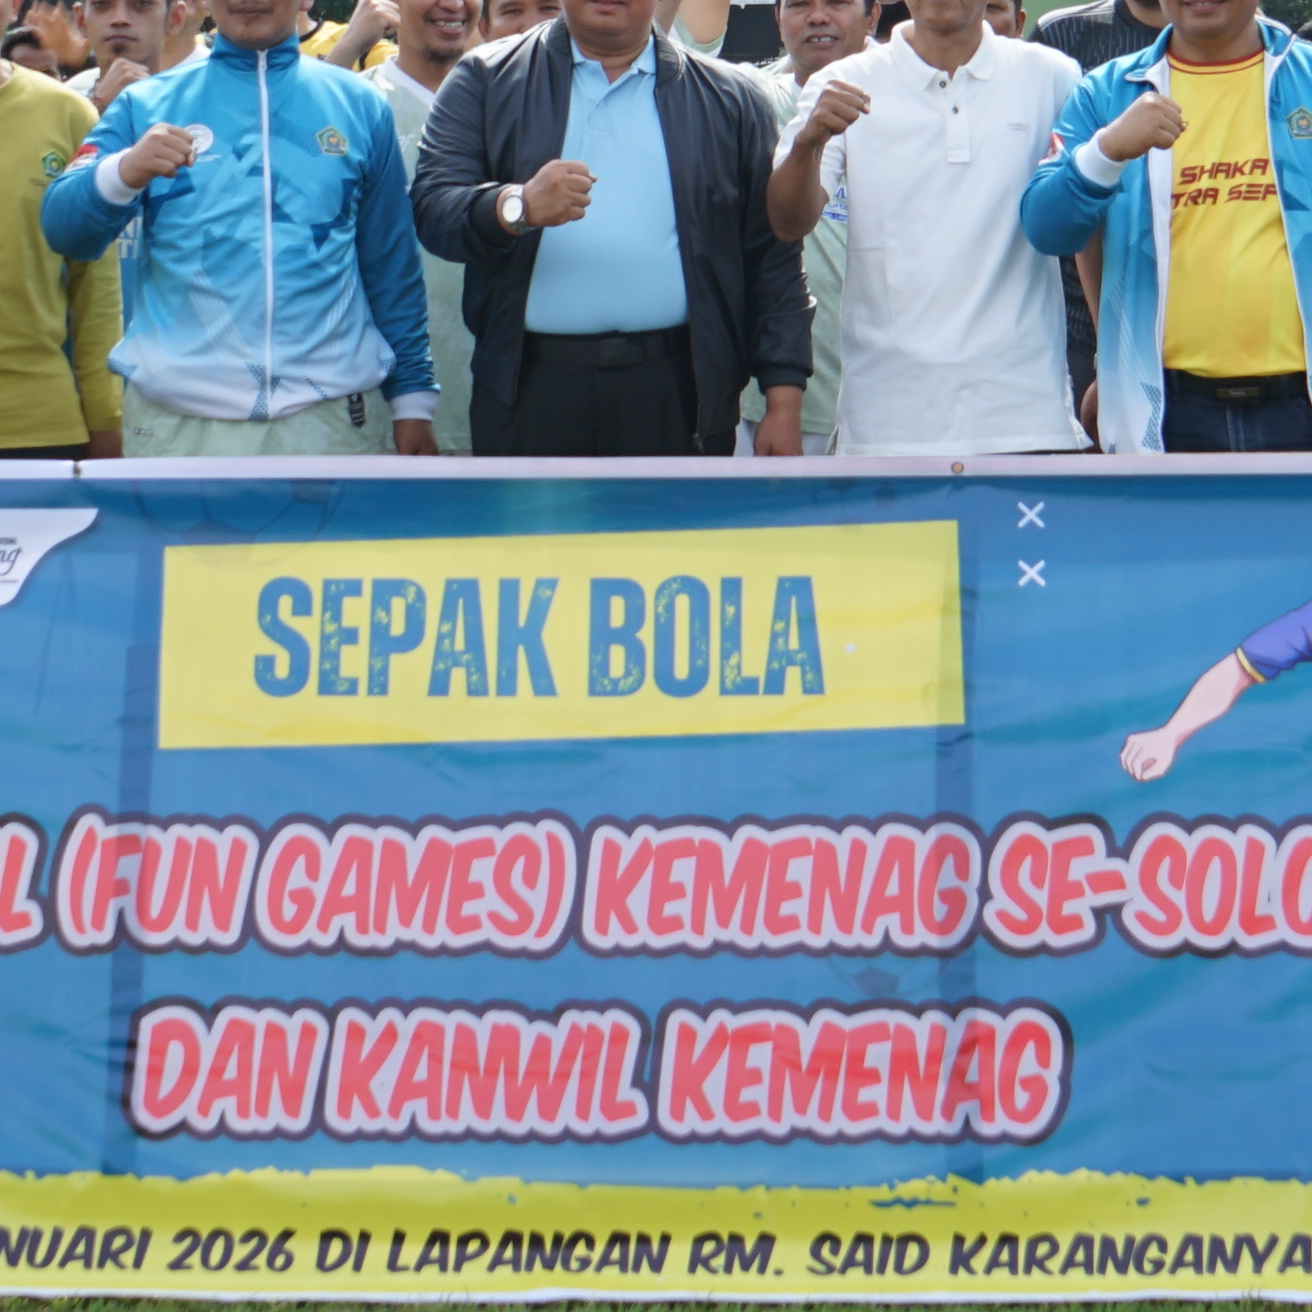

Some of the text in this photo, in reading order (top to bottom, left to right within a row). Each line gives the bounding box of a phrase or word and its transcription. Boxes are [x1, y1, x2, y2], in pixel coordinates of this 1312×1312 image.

[1176, 157, 1270, 186] SHAKA
[253, 574, 826, 698] SEPAK BOLA
[68, 825, 249, 935] (FUN
[266, 830, 567, 939] GAMES)
[593, 833, 971, 938] KEMENAG
[141, 1017, 1053, 1125] DAN KANWIL KEMENAG
[166, 1227, 297, 1272] 2026
[315, 1228, 373, 1273] DI
[386, 1228, 672, 1274] LAPANGAN
[687, 1230, 785, 1276] RM.
[805, 1230, 931, 1276] SAID
